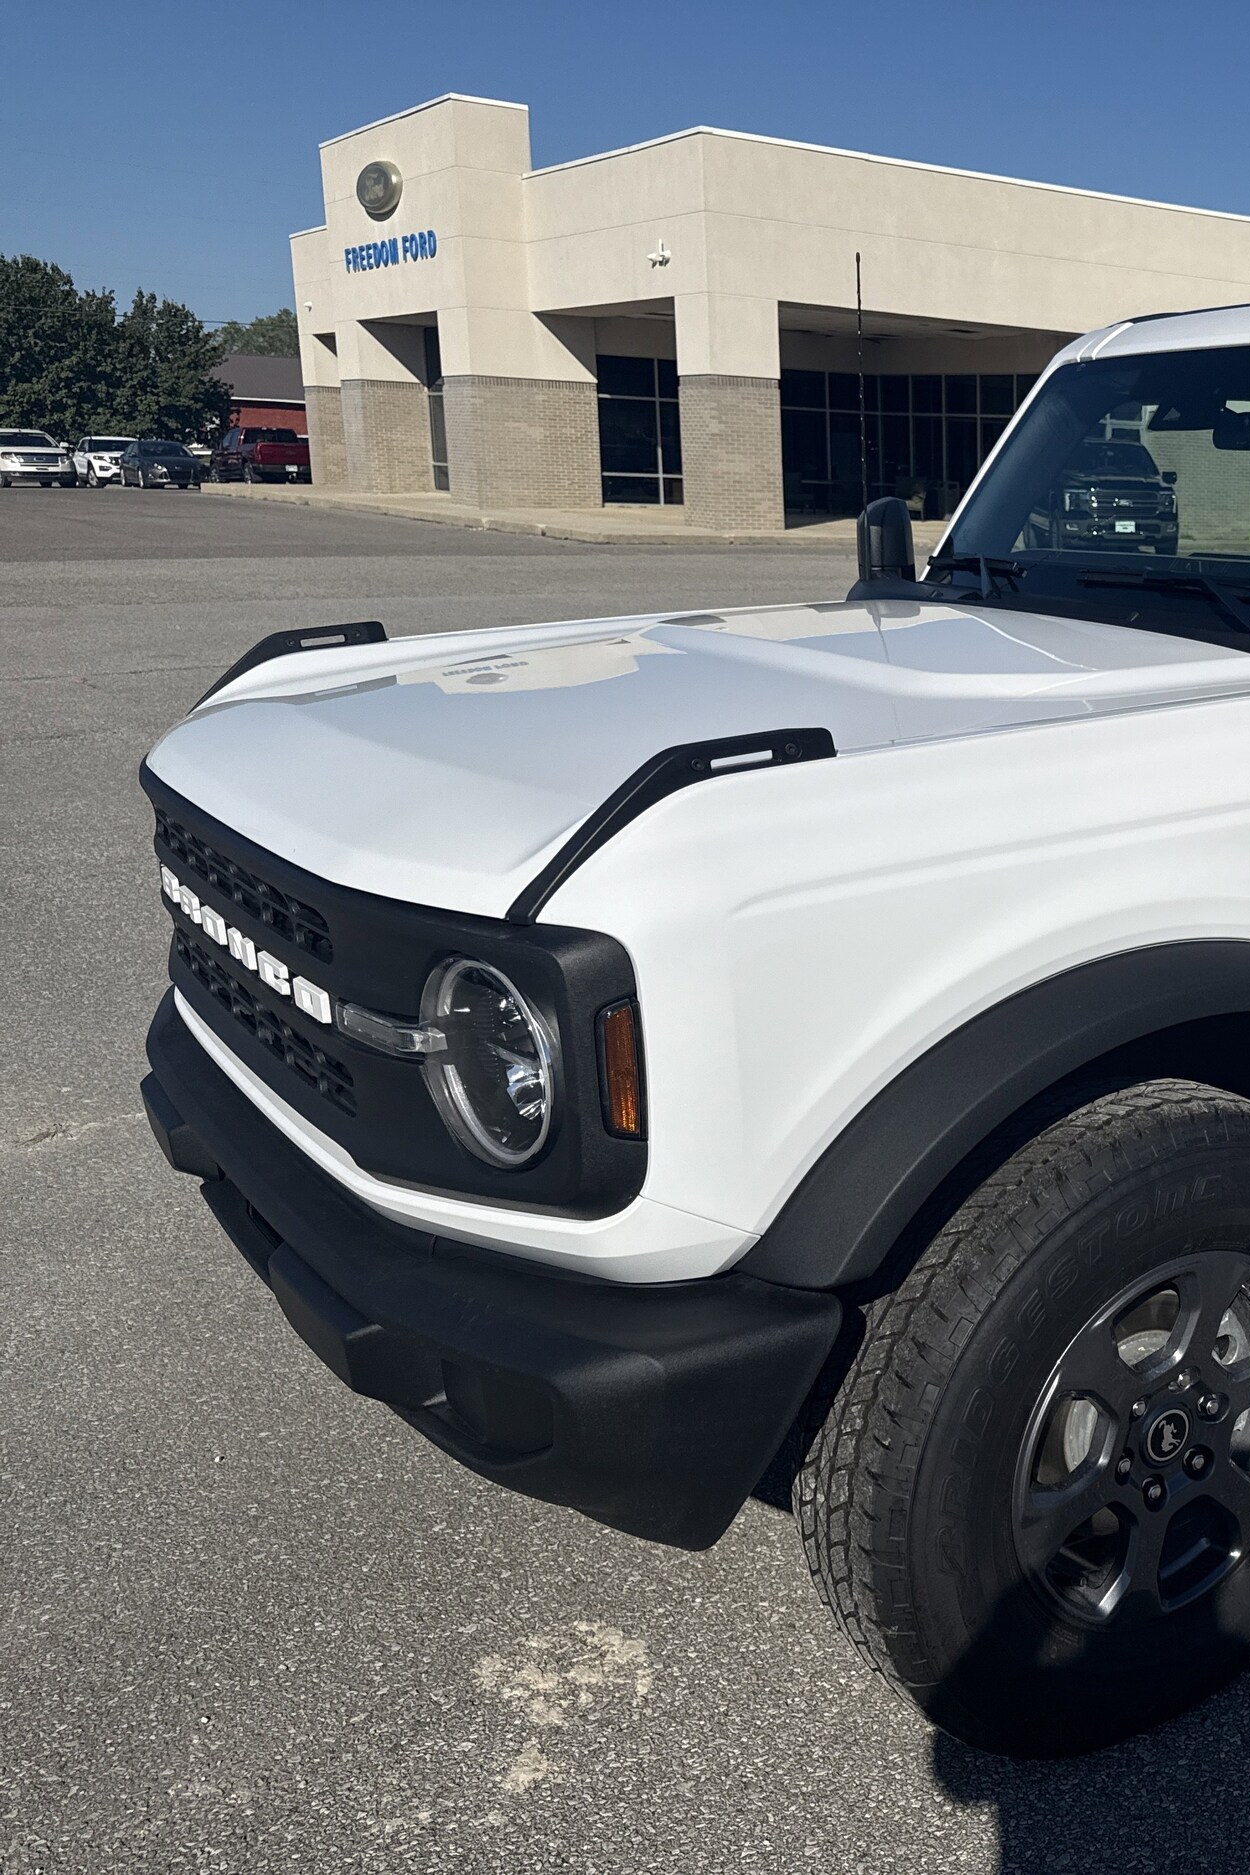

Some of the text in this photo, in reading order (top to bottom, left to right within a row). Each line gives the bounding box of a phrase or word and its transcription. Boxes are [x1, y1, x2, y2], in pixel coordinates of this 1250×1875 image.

[344, 230, 438, 274] FREEDOM FORD
[161, 864, 332, 1024] BRONCO
